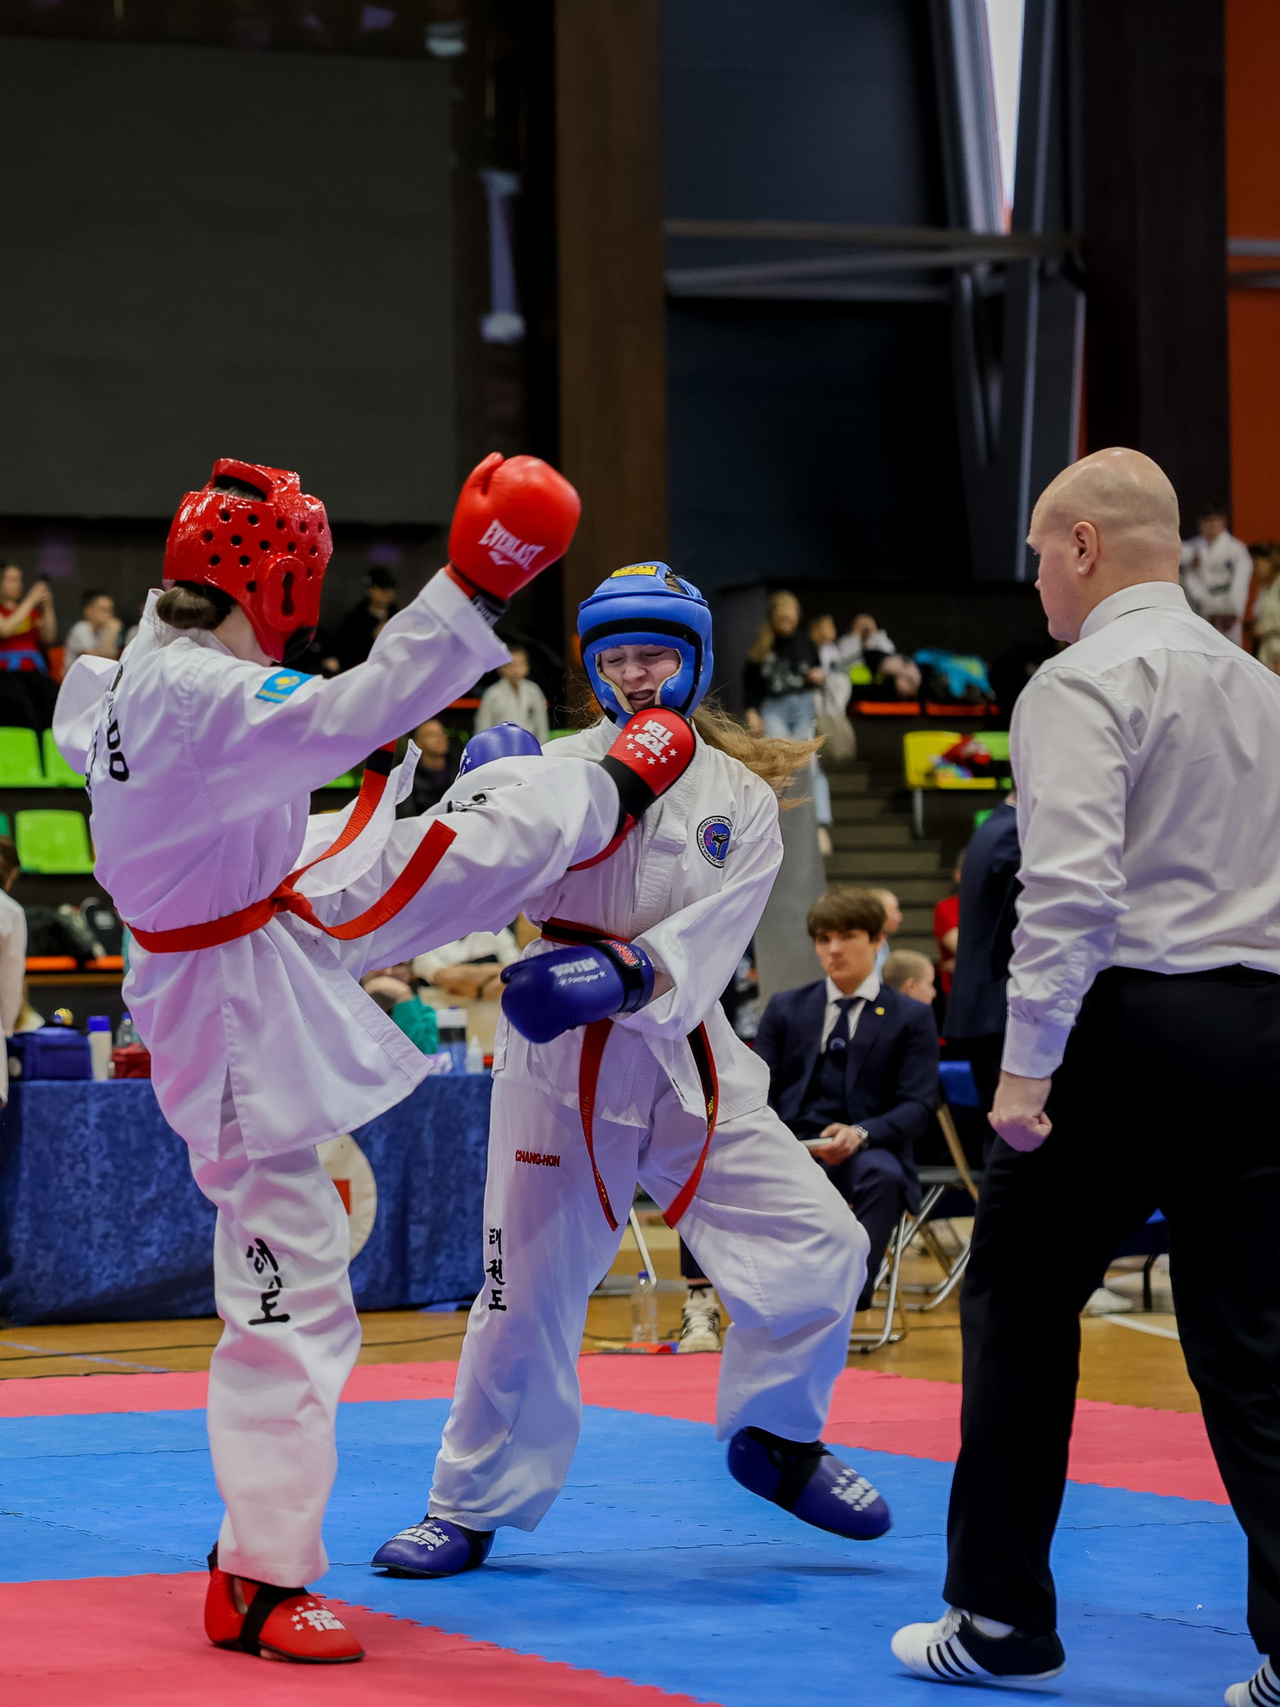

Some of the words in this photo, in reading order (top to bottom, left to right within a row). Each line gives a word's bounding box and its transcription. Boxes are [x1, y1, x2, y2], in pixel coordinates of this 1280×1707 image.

[478, 518, 546, 571] EVERLAST
[633, 732, 666, 757] TOP
[642, 720, 674, 746] TEN
[515, 1149, 560, 1167] CHANG-HON
[485, 1227, 507, 1312] 태권도
[301, 1609, 336, 1626] TOP
